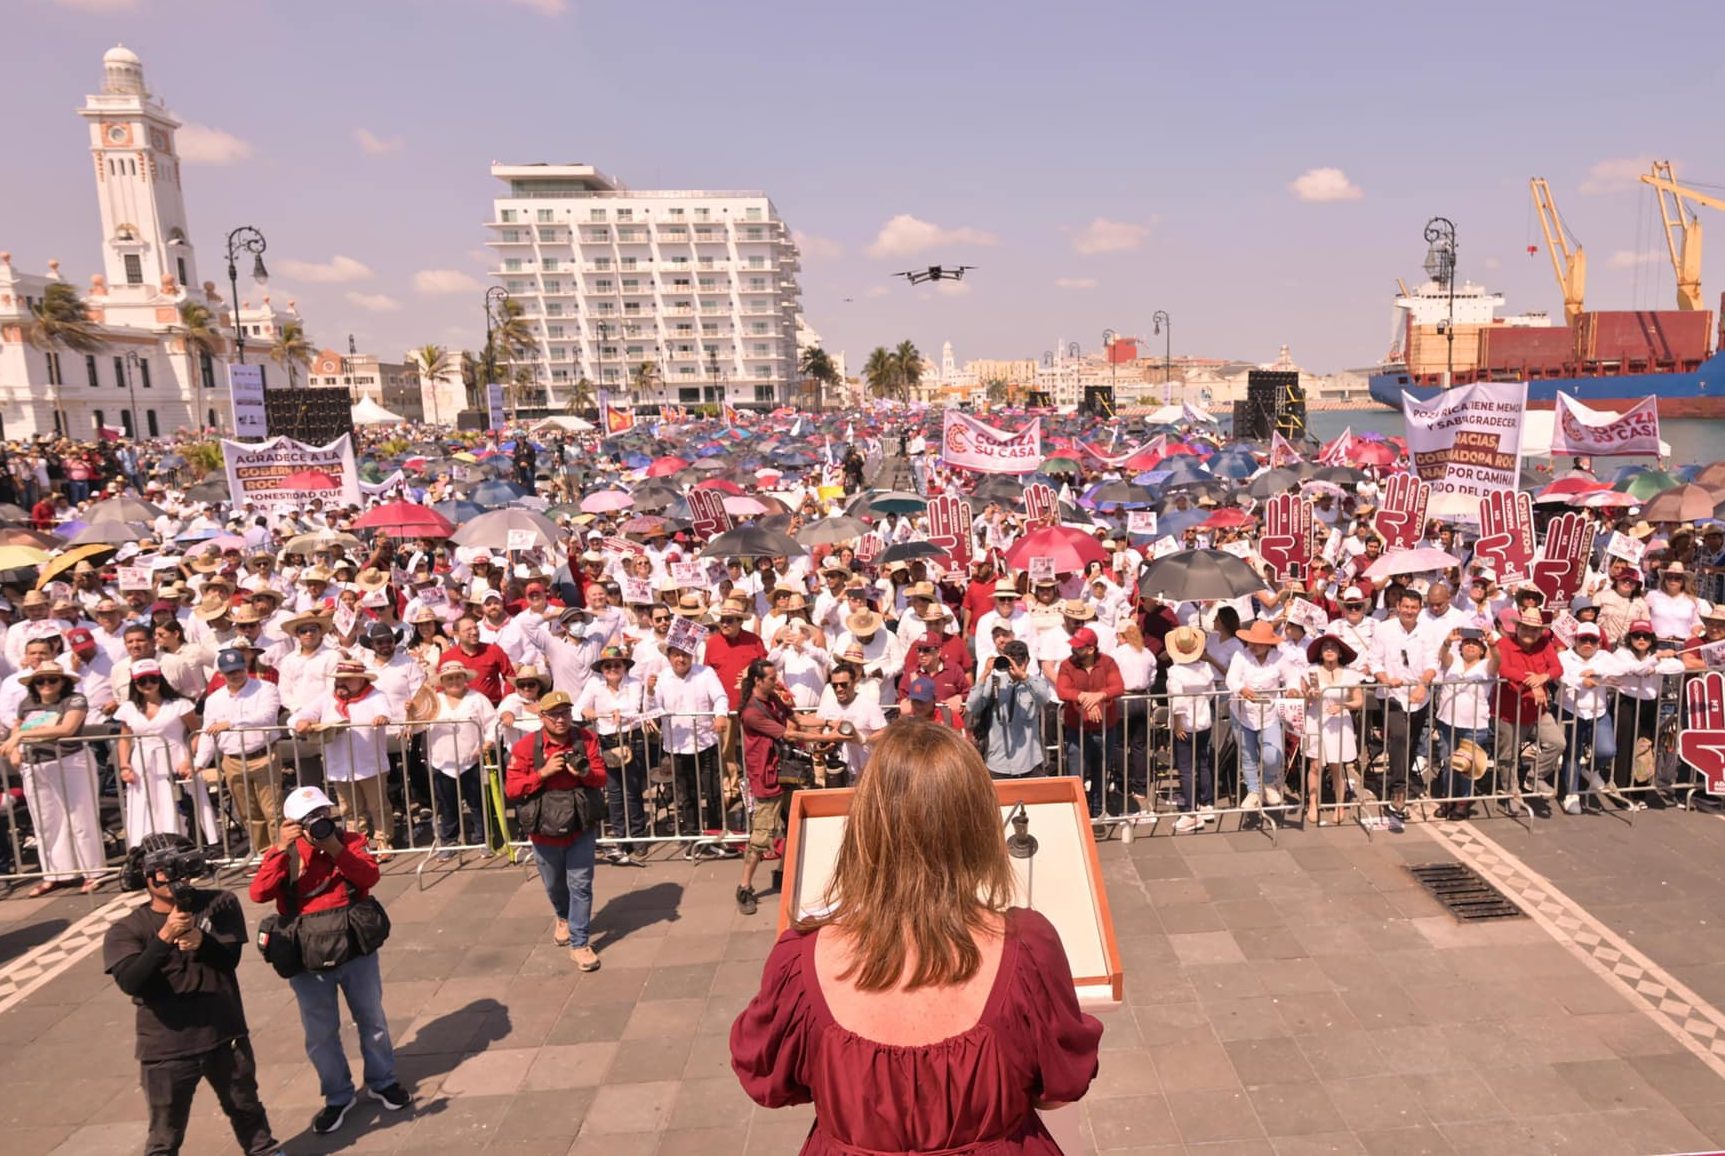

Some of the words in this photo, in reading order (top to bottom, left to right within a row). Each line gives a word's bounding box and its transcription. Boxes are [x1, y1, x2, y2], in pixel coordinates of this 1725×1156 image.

[236, 453, 305, 464] AGRADECE
[311, 453, 320, 461] A
[323, 451, 340, 460] LA
[975, 446, 994, 455] SU
[998, 447, 1035, 457] CASA
[1447, 466, 1473, 479] POR
[320, 489, 343, 498] QUE
[1518, 495, 1529, 522] RICA
[1521, 523, 1533, 555] POZA
[1571, 525, 1582, 558] MARCHA
[1711, 700, 1719, 712] EN
